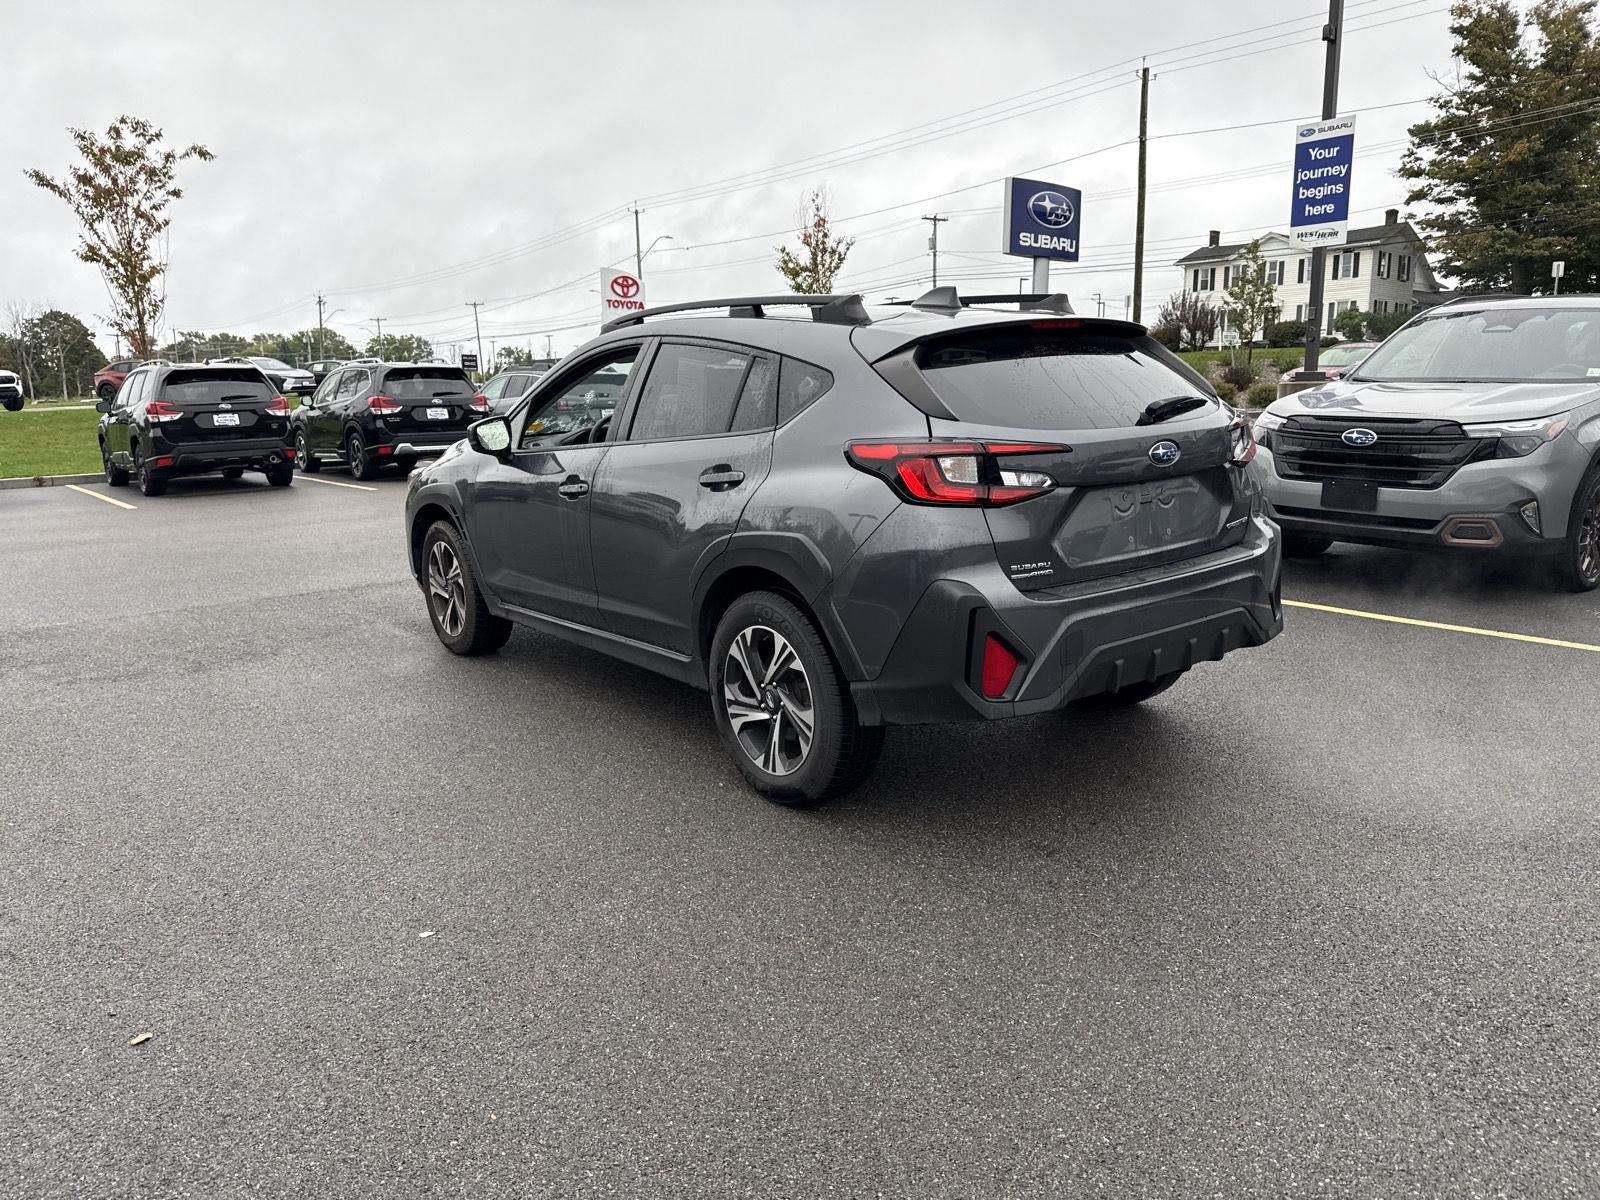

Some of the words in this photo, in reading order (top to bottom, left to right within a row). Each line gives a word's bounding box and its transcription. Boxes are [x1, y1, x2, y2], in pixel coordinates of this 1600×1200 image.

[1317, 122, 1352, 134] SUBARU
[1309, 146, 1340, 161] Your
[1296, 163, 1349, 184] journey
[1298, 183, 1344, 200] begins
[1304, 203, 1335, 217] here
[1019, 232, 1076, 252] SUBARU
[606, 299, 645, 310] TOYOTA
[1010, 561, 1051, 571] SUBARU
